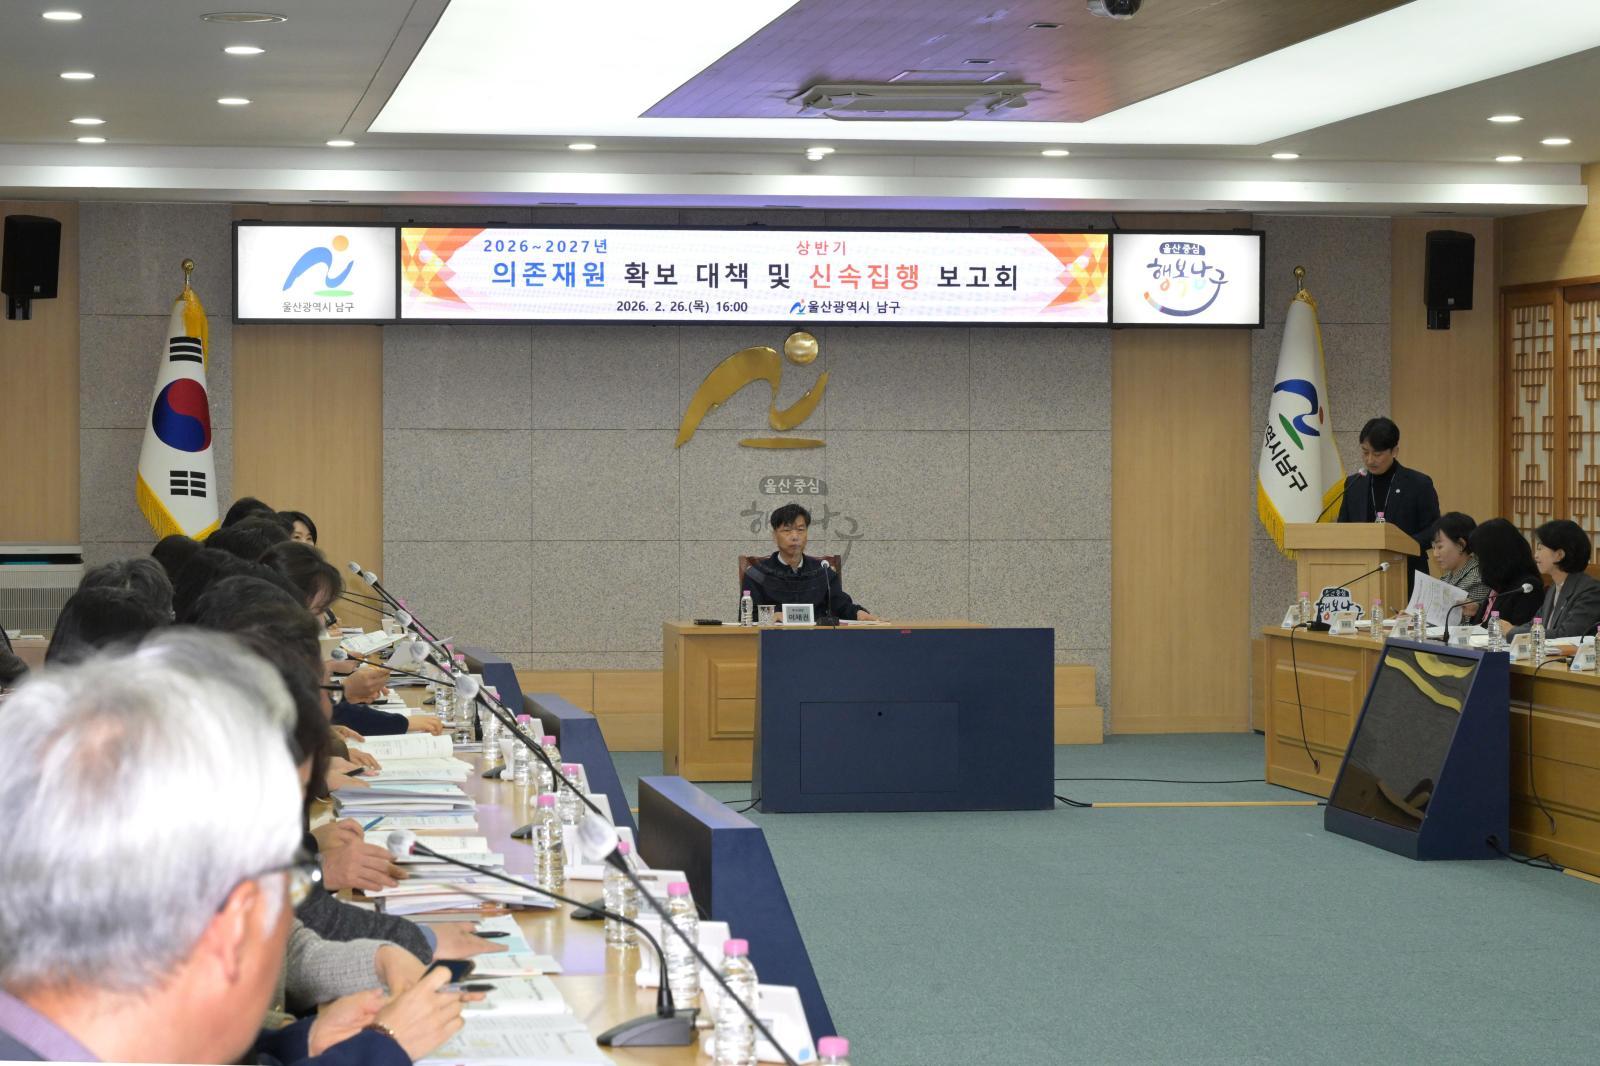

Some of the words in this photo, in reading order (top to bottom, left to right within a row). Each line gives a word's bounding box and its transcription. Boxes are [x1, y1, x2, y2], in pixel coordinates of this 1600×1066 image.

[483, 238, 607, 254] 2026~2027년
[796, 240, 846, 256] 상반기
[491, 260, 605, 288] 의존재원
[623, 261, 679, 289] 확보
[696, 262, 748, 289] 대책
[768, 262, 791, 289] 및
[809, 263, 919, 290] 신속집행
[936, 264, 1018, 291] 보고회
[282, 301, 331, 313] 울산광역시
[335, 301, 355, 313] 남구
[616, 300, 649, 312] 2026.
[654, 300, 666, 312] 2.
[716, 300, 749, 313] 16:00
[807, 300, 870, 315] 울산광역시
[876, 300, 901, 315] 남구
